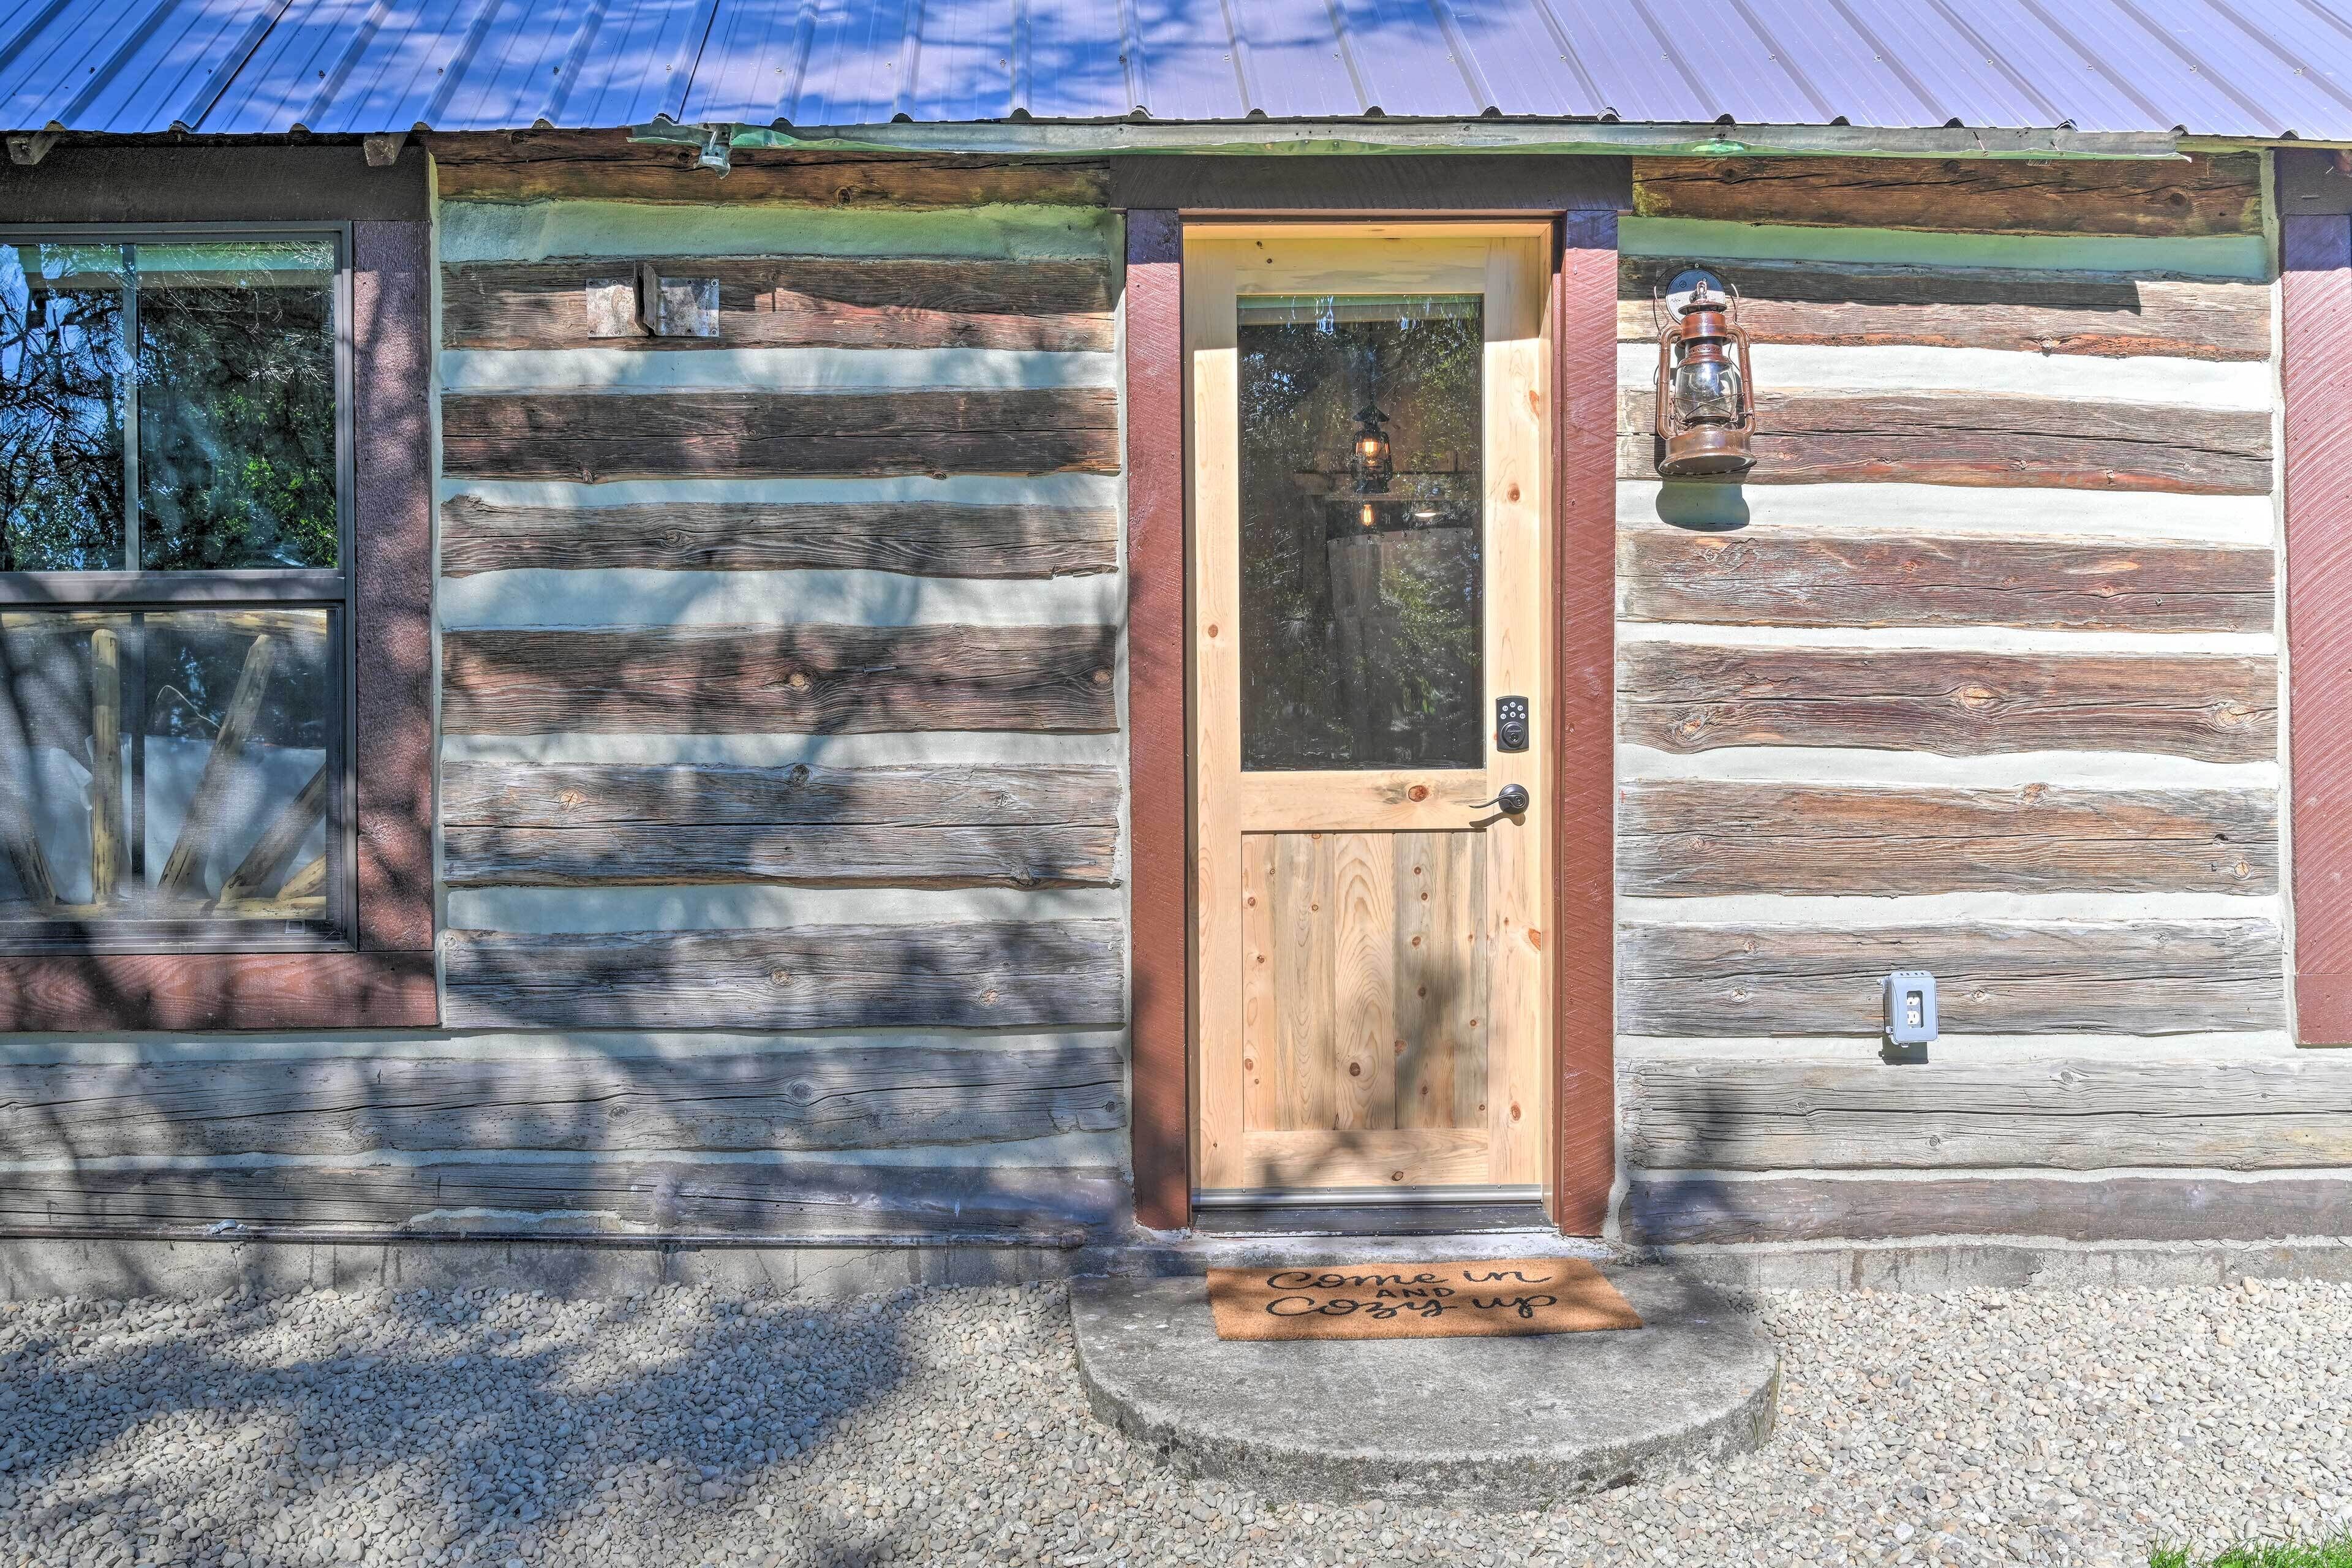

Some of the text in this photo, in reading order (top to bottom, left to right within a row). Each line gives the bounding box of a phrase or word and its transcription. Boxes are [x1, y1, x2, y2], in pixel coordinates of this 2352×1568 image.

[1267, 1270, 1552, 1289] Come in
[1376, 1287, 1455, 1298] AND
[1266, 1295, 1558, 1319] Cozy up
